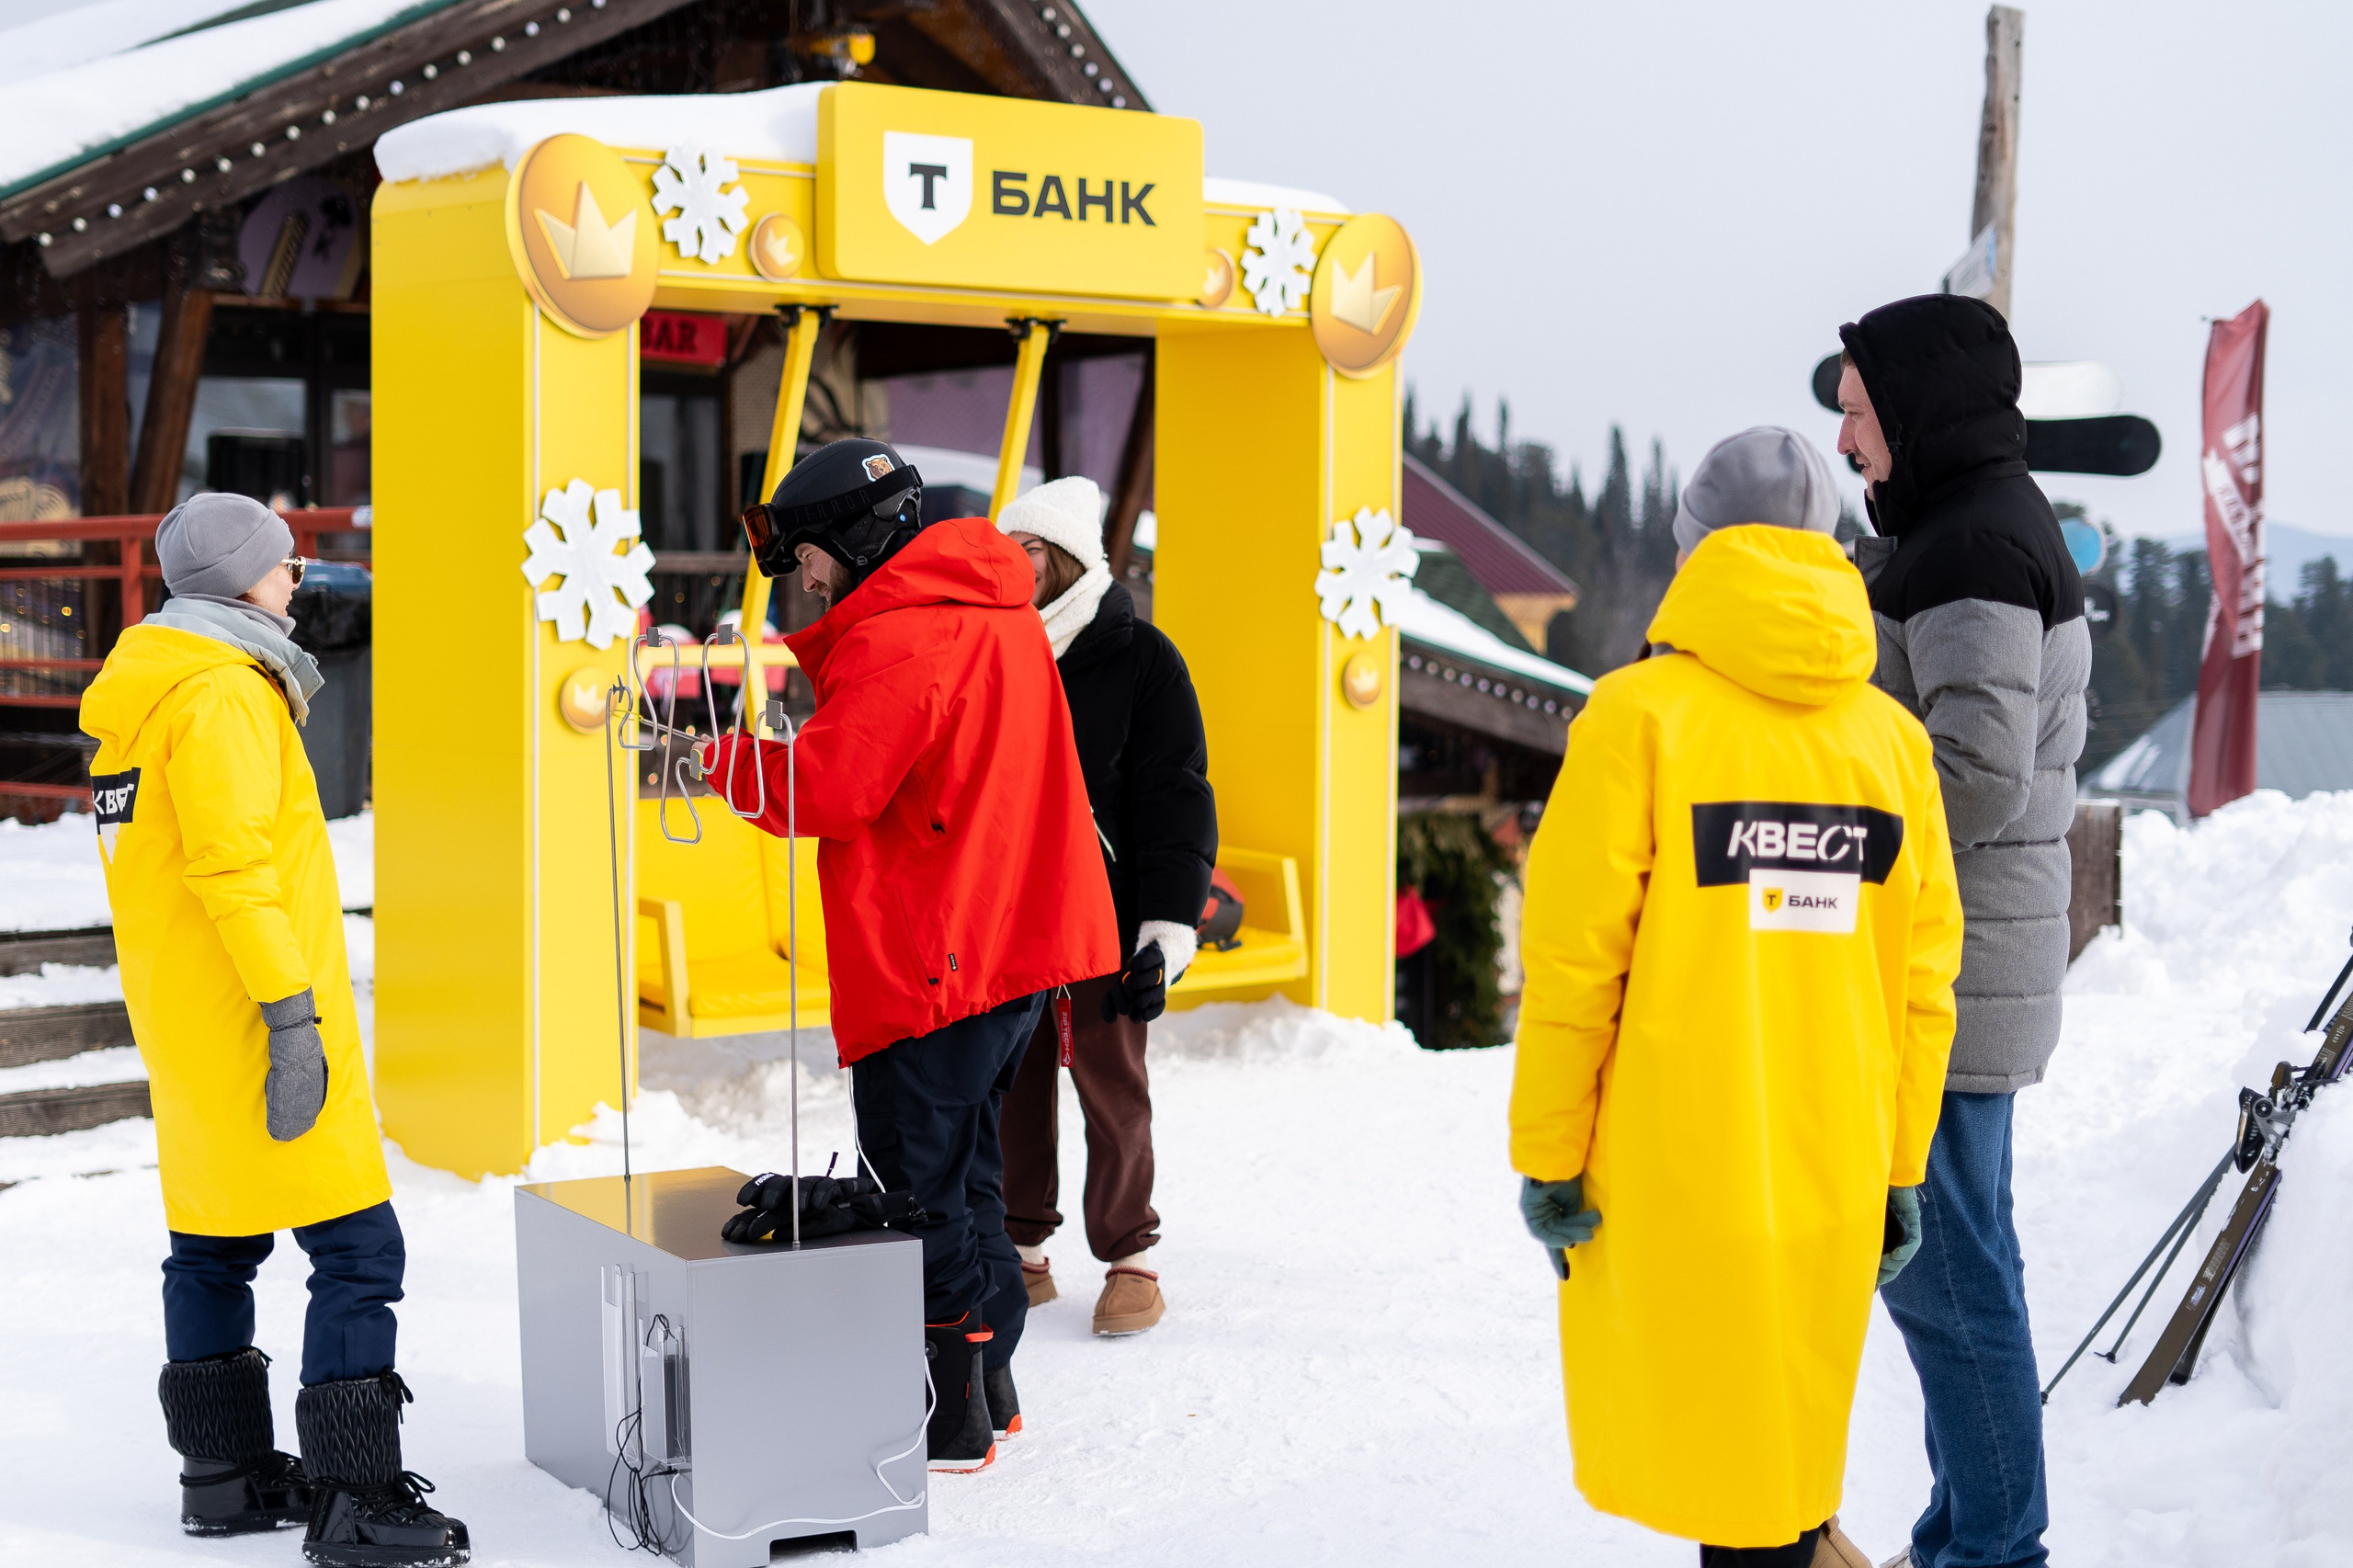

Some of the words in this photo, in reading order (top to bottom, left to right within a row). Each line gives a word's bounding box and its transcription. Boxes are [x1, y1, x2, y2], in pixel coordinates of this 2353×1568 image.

[909, 162, 948, 210] Т
[993, 170, 1156, 226] БАНК
[793, 490, 871, 524] TERROR
[1727, 821, 1868, 861] КВЕСТ
[1788, 895, 1838, 909] БАНК
